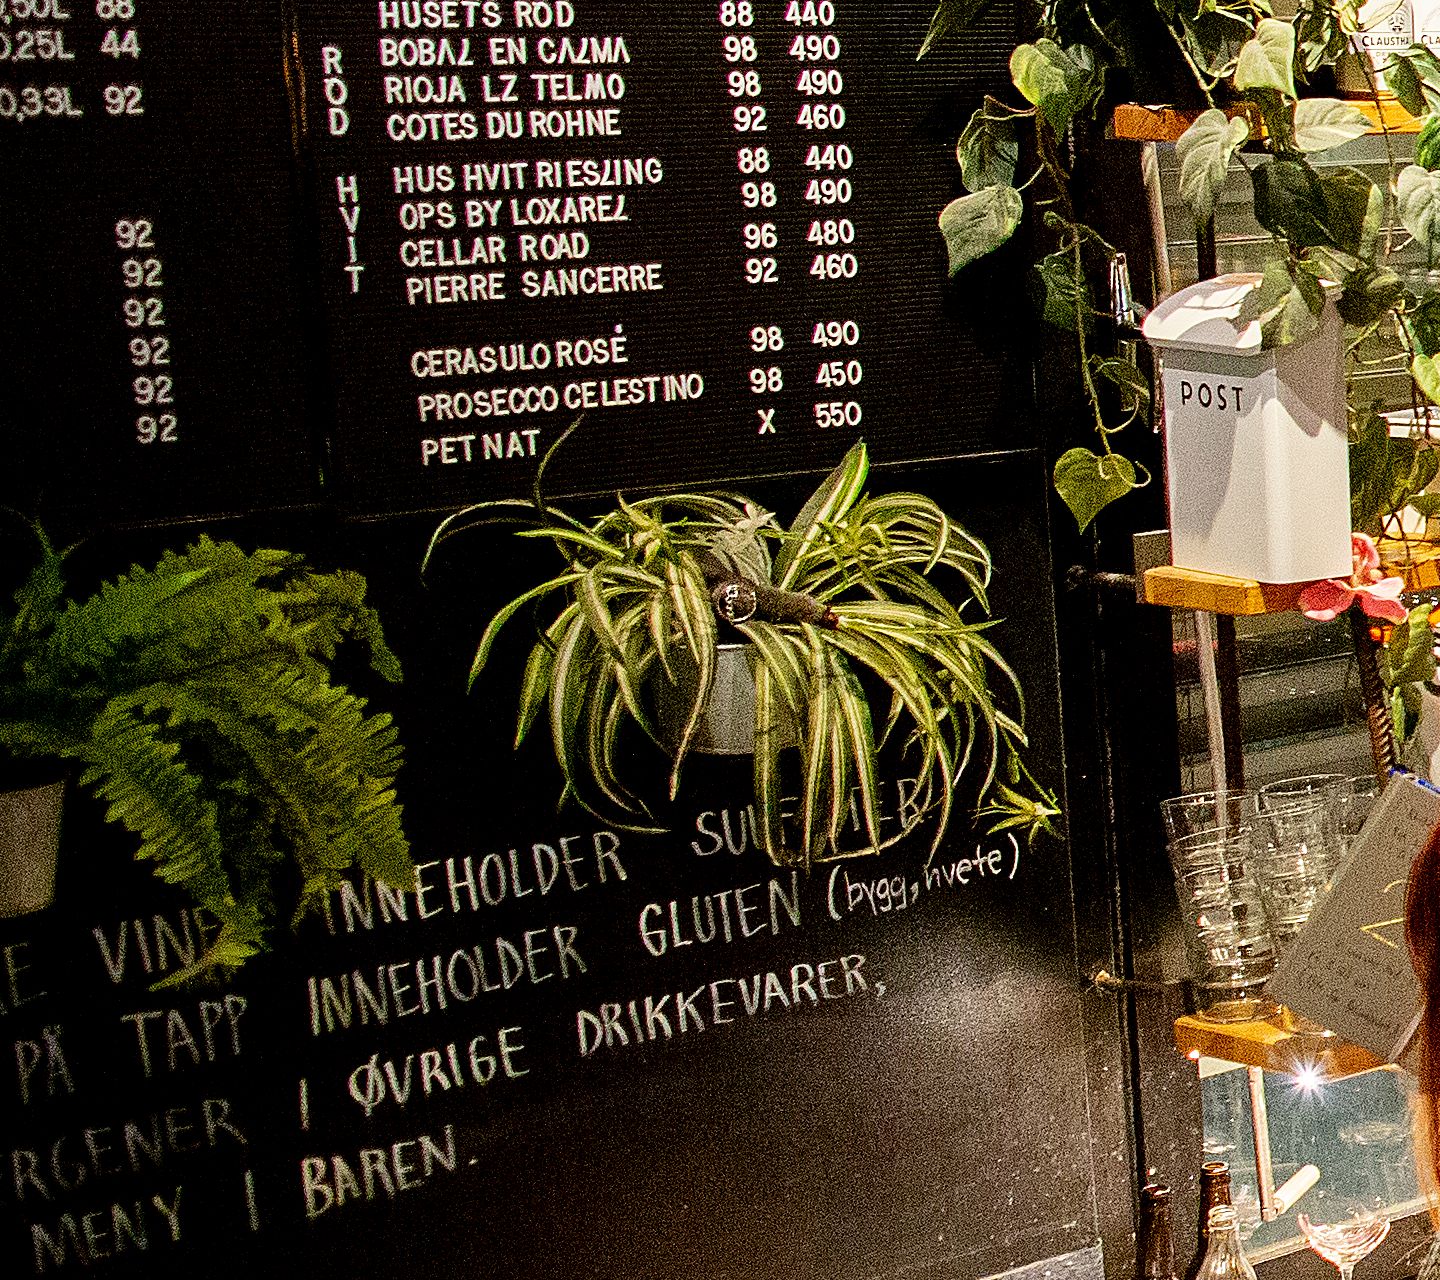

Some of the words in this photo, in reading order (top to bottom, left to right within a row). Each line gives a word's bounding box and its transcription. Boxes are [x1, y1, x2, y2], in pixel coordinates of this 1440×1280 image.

[379, 0, 502, 28] HUSETS
[489, 38, 526, 65] EN
[724, 36, 757, 61] 98
[104, 86, 144, 114] 92
[384, 76, 466, 103] RIOJA
[482, 74, 518, 102] LZ
[530, 73, 625, 100] TELMO
[387, 112, 478, 141] COTES
[486, 111, 523, 138] DU
[530, 109, 621, 137] ROHNE
[394, 164, 455, 193] HUS
[463, 162, 528, 191] HVIT
[400, 202, 456, 230] OPS
[466, 200, 502, 227] BY
[400, 236, 506, 267] CELLAR
[520, 232, 589, 261] ROAD
[807, 219, 854, 245] 480
[406, 273, 505, 304] PIERRE
[522, 264, 663, 297] SANCERRE
[411, 342, 551, 377] CERASULO
[418, 386, 559, 421] PROSECCO
[564, 374, 703, 409] CELESTINO
[1180, 379, 1245, 413] POST
[422, 435, 475, 465] PET
[482, 429, 540, 459] NAT
[123, 993, 251, 1078] TAPP
[305, 924, 591, 1038] INNEHOLDER
[637, 873, 801, 958] GLUTEN
[348, 1027, 530, 1119] ØVRIGE
